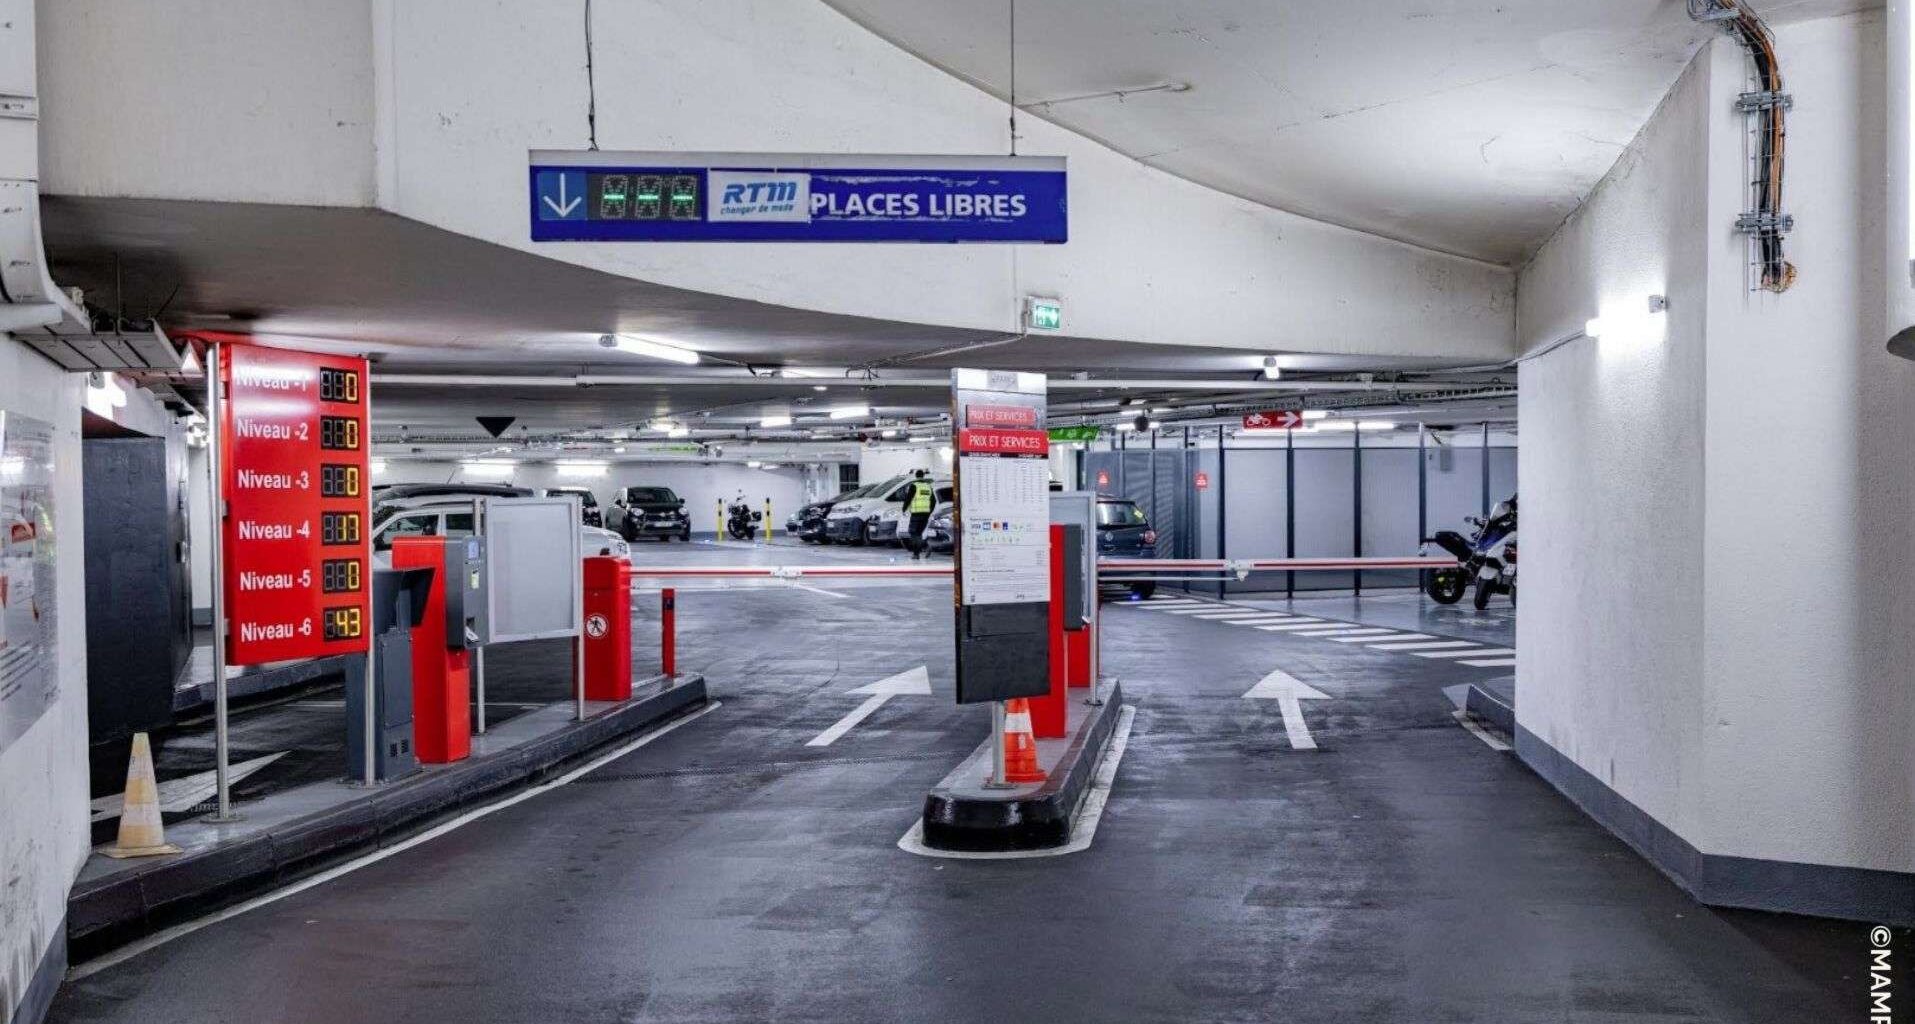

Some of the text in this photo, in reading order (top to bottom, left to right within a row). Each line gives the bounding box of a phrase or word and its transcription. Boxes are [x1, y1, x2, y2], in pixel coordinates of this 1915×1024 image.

[723, 182, 797, 204] RTM
[811, 193, 1026, 216] PLACES LIBRES
[237, 419, 308, 440] Niveau -2
[969, 435, 1040, 449] PRIX ET SERVICES
[238, 469, 309, 489] Niveau -3
[239, 520, 310, 539] Niveau -4
[343, 514, 359, 541] 17
[240, 569, 311, 590] Niveau -5
[241, 618, 312, 642] Niveau -6
[336, 608, 360, 636] 43
